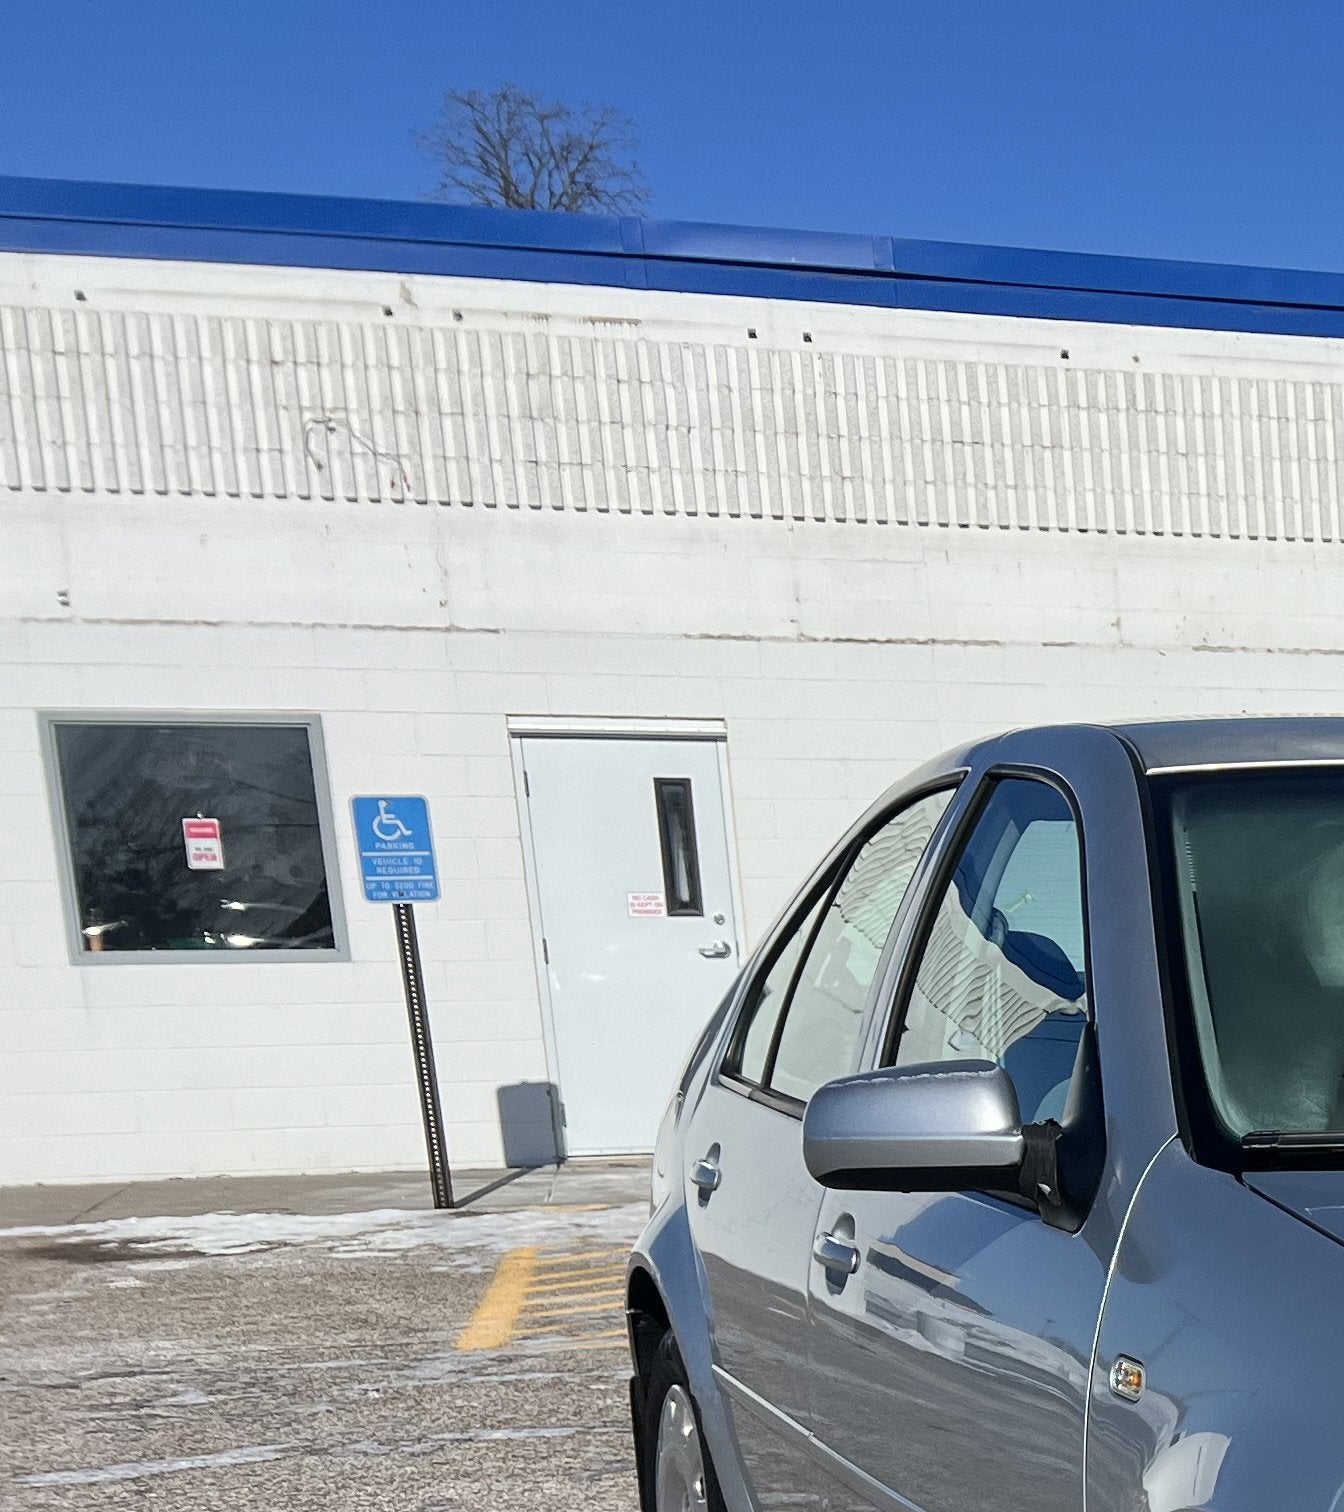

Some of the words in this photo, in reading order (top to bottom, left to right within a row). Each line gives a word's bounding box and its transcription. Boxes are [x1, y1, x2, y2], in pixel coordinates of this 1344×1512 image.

[375, 842, 415, 850] PARKING
[372, 857, 408, 865] VEHICLE
[414, 857, 423, 865] ID
[376, 866, 420, 874] REQUIRED
[366, 882, 377, 890] UP
[381, 881, 391, 889] TO
[373, 891, 388, 899] FOR
